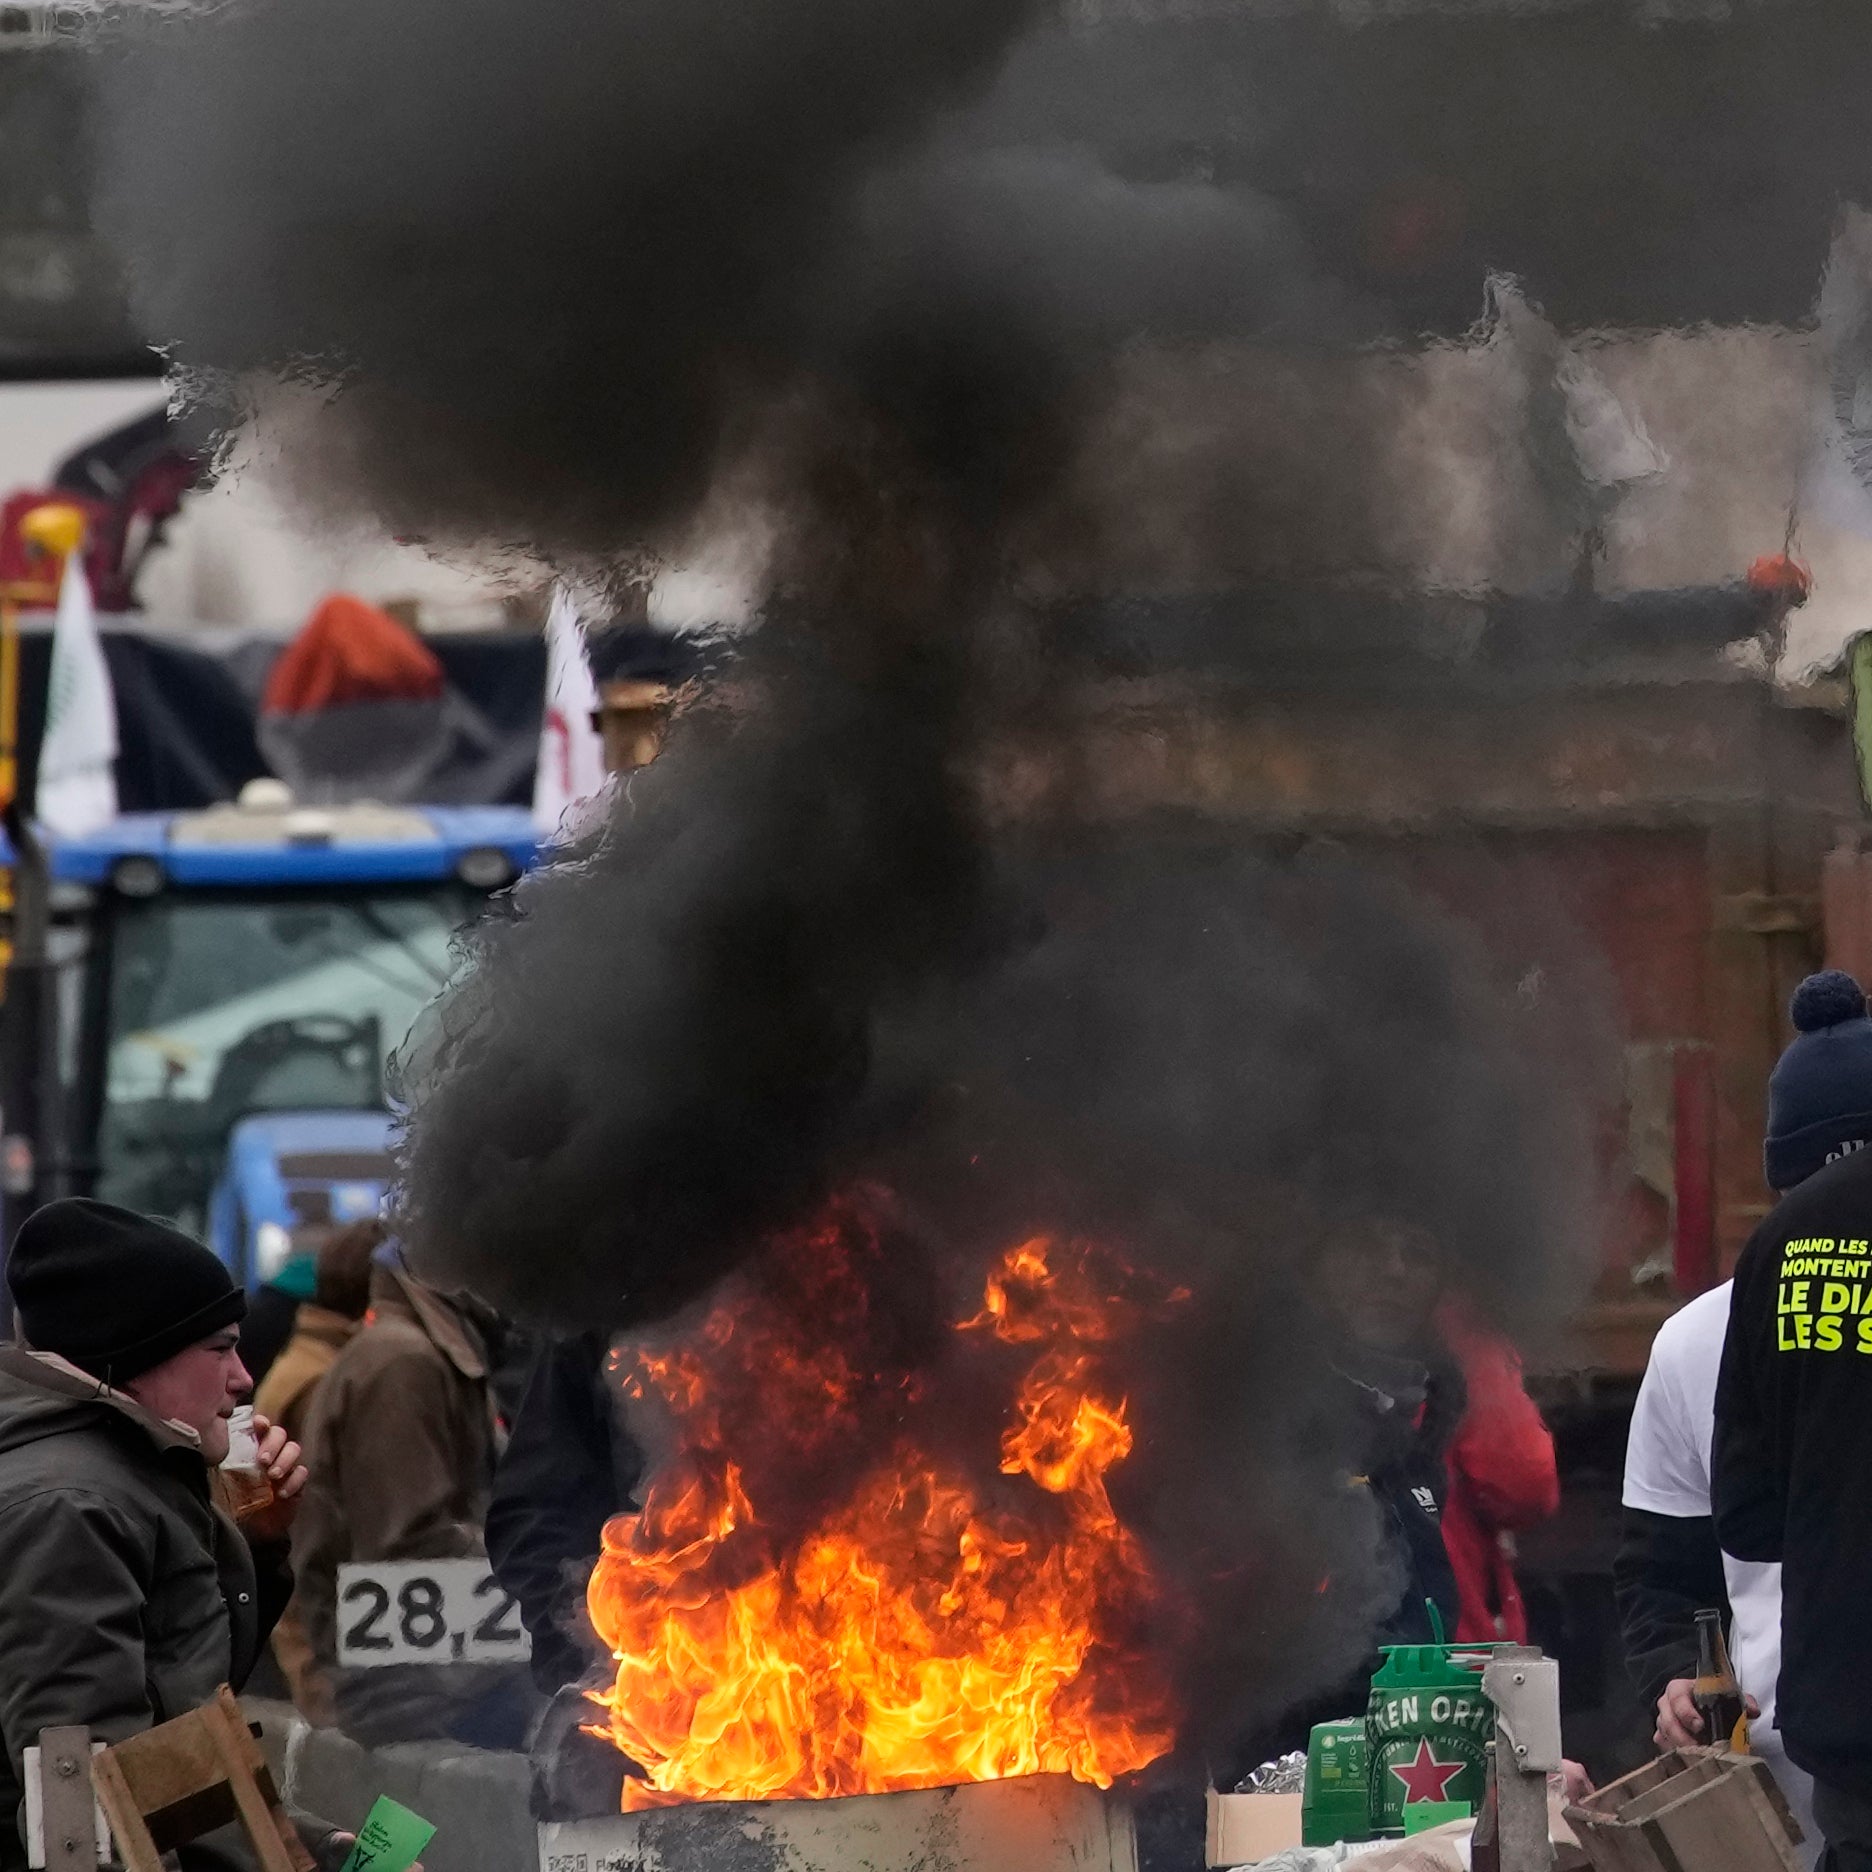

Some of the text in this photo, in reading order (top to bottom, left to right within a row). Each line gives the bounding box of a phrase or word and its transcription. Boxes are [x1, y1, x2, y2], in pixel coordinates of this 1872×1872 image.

[1785, 1238, 1835, 1258] QUAND
[1838, 1239, 1869, 1256] LES
[1780, 1258, 1872, 1279] MONTENT
[1777, 1281, 1811, 1315] LE
[1777, 1314, 1844, 1352] LES
